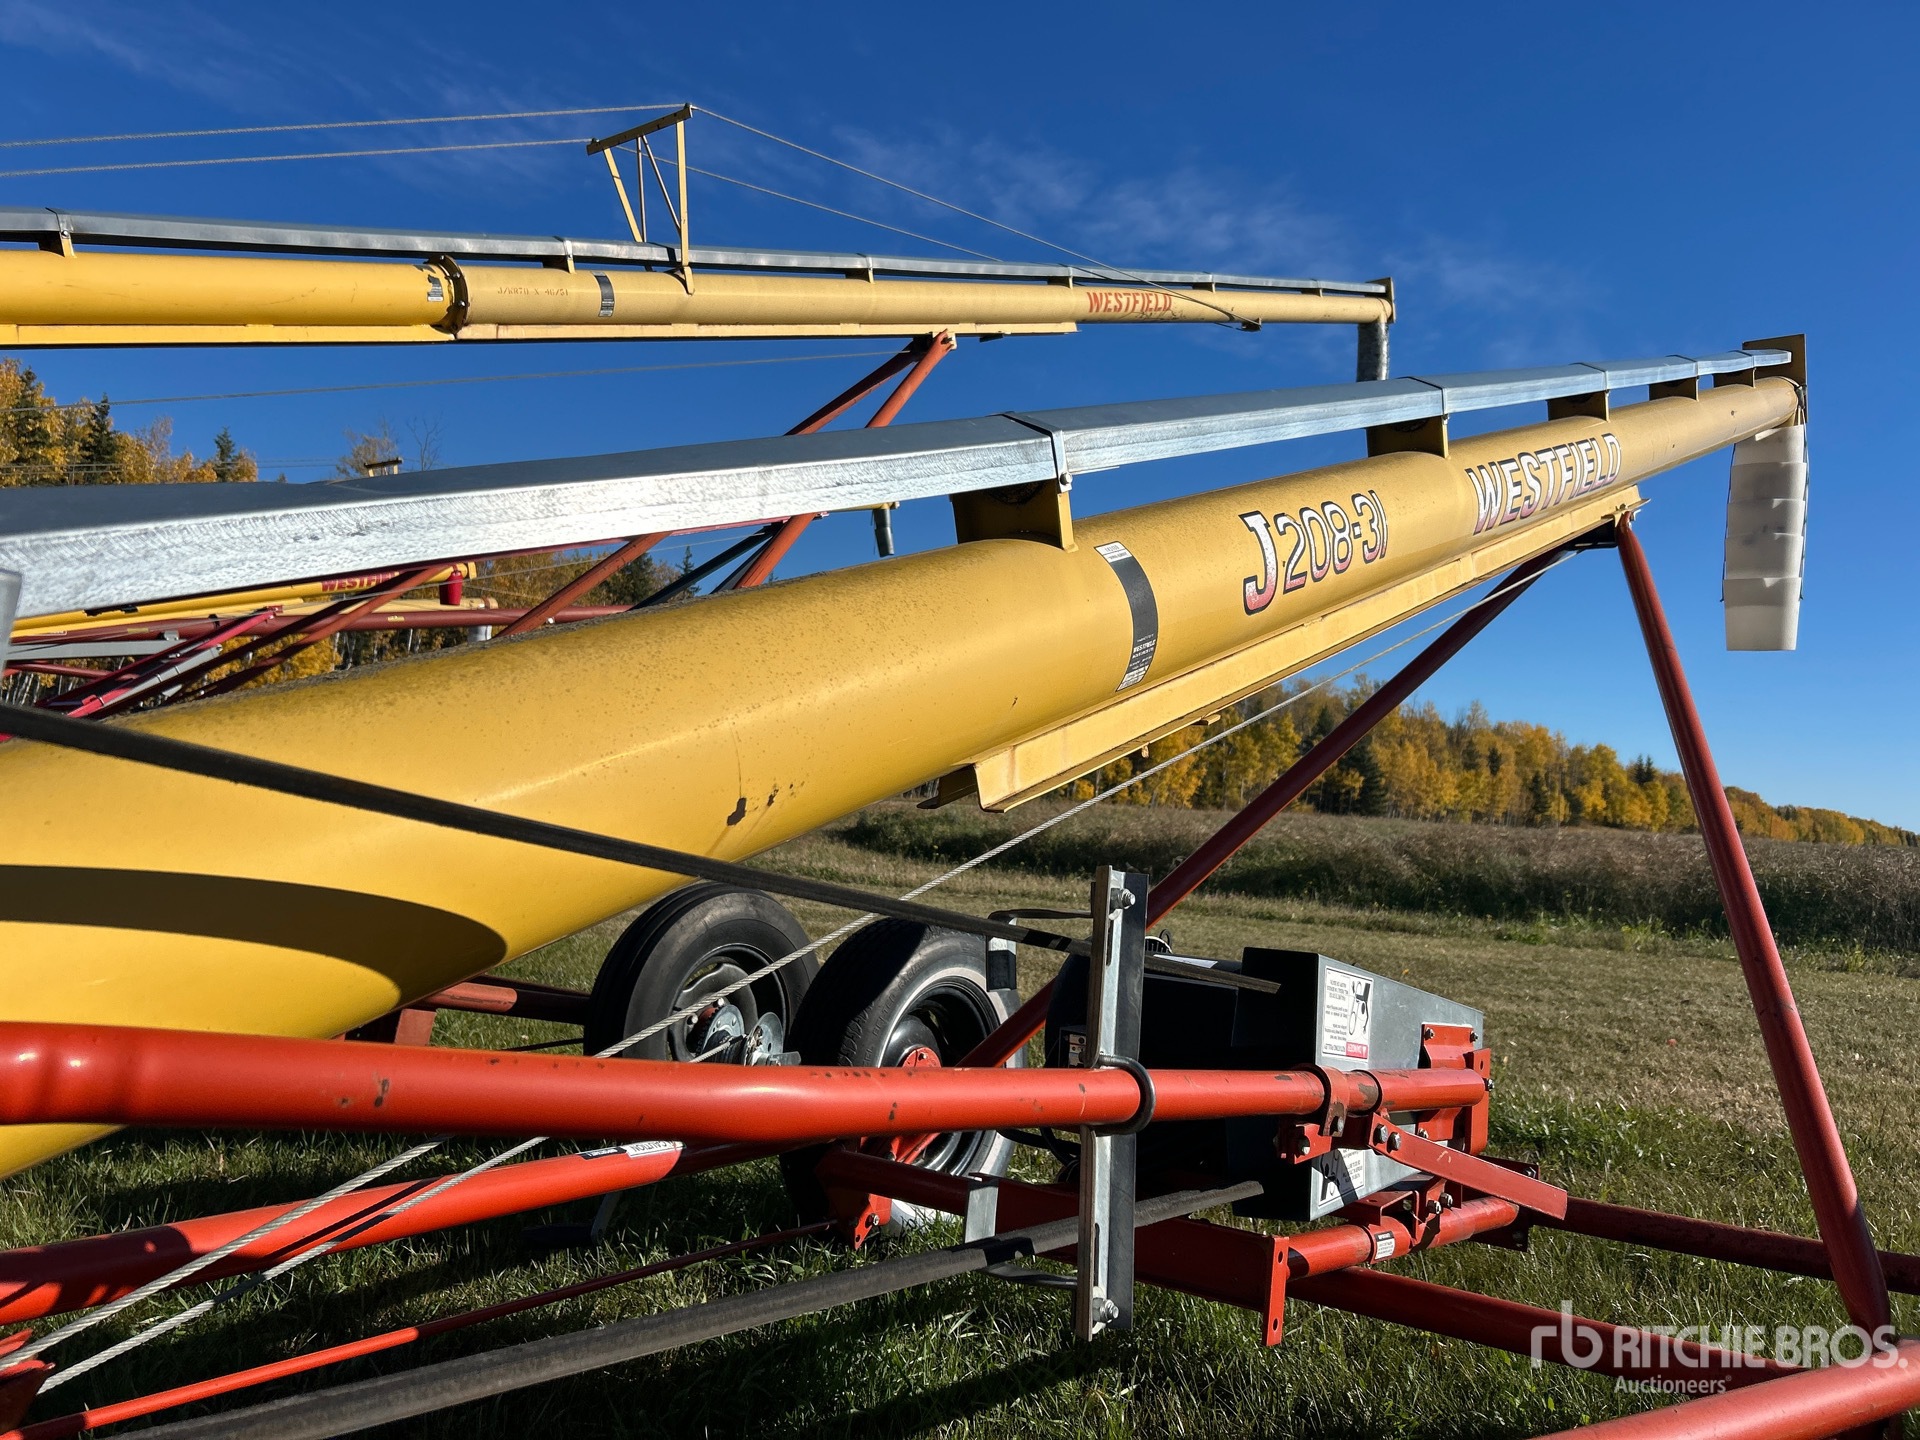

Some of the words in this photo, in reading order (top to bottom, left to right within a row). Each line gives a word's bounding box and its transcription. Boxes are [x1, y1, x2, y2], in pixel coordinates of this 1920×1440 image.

[1086, 291, 1173, 313] WESTFIELD
[1465, 433, 1623, 535] WESTFIELD
[1239, 489, 1389, 616] J208-31
[630, 1140, 667, 1152] CAUTION
